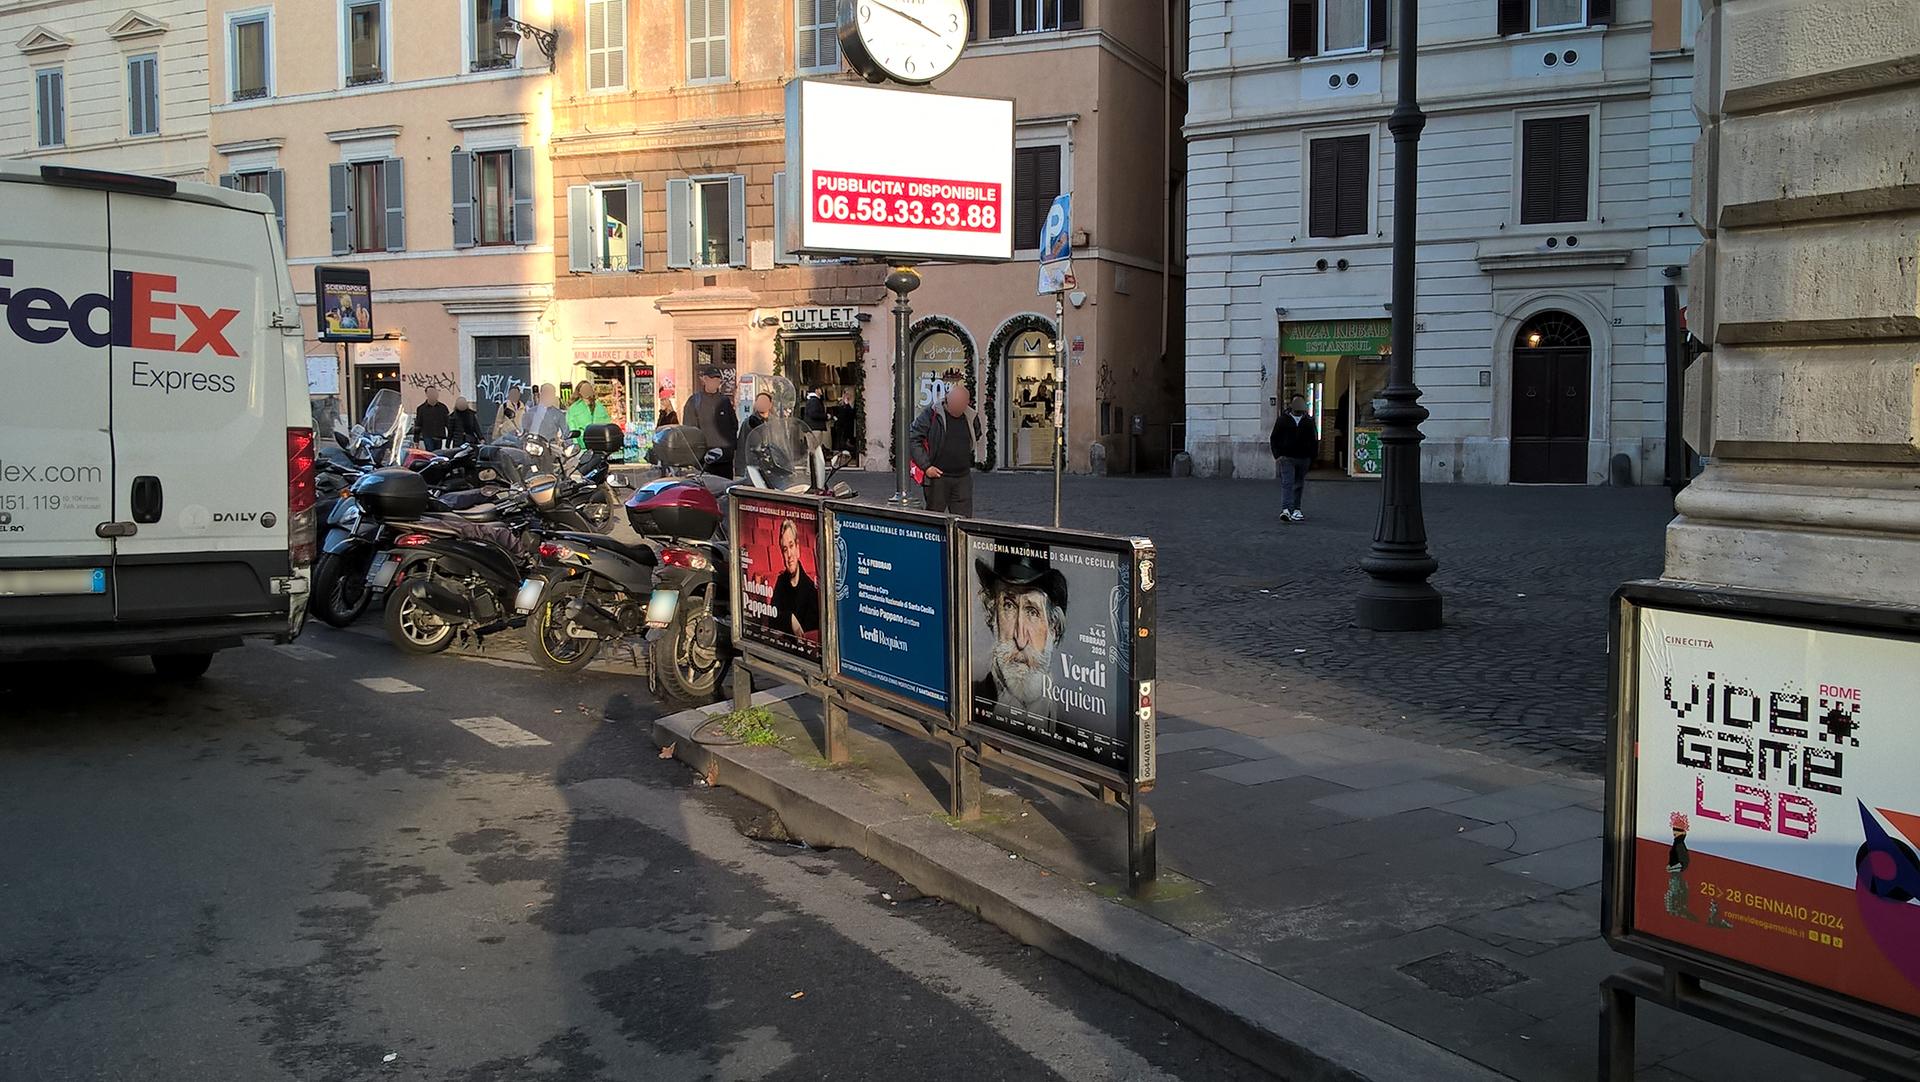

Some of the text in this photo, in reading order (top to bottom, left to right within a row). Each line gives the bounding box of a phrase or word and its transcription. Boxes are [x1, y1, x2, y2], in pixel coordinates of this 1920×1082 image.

[860, 5, 871, 24] 9
[948, 13, 958, 33] 3
[904, 56, 916, 74] 6
[817, 175, 997, 201] PUBBLICITA' DISPONIBILE
[818, 194, 996, 228] 06.58.33.33.88
[325, 284, 367, 292] SCIENTOPOLIS
[782, 308, 853, 322] OUTLET
[784, 321, 816, 329] SCARPE
[1333, 320, 1390, 339] KEBAB
[574, 351, 589, 359] MINI
[592, 351, 621, 359] MARKET
[1306, 340, 1372, 353] ISTANBUL
[132, 361, 236, 394] Express
[0, 459, 101, 482] ex.com
[213, 512, 257, 522] DAILY
[842, 520, 869, 530] ACCADEMIA
[870, 525, 898, 535] NAZIONALE
[899, 528, 905, 536] DI
[906, 530, 923, 539] SANTA
[972, 541, 1115, 569] ACCADEMIA NAZIONALE DI SANTA CECILIA
[742, 574, 774, 598] Antonio
[743, 592, 778, 618] Pappano
[859, 624, 908, 652] Verdi Requiem
[1079, 634, 1105, 647] FEBBRAIO
[1091, 646, 1105, 655] 2024
[1061, 653, 1105, 688] Verdi
[1042, 674, 1106, 715] Requiem
[1819, 684, 1861, 700] ROME
[1726, 888, 1741, 903] 28
[1744, 893, 1808, 920] GENNAIO
[1811, 910, 1845, 931] 2024
